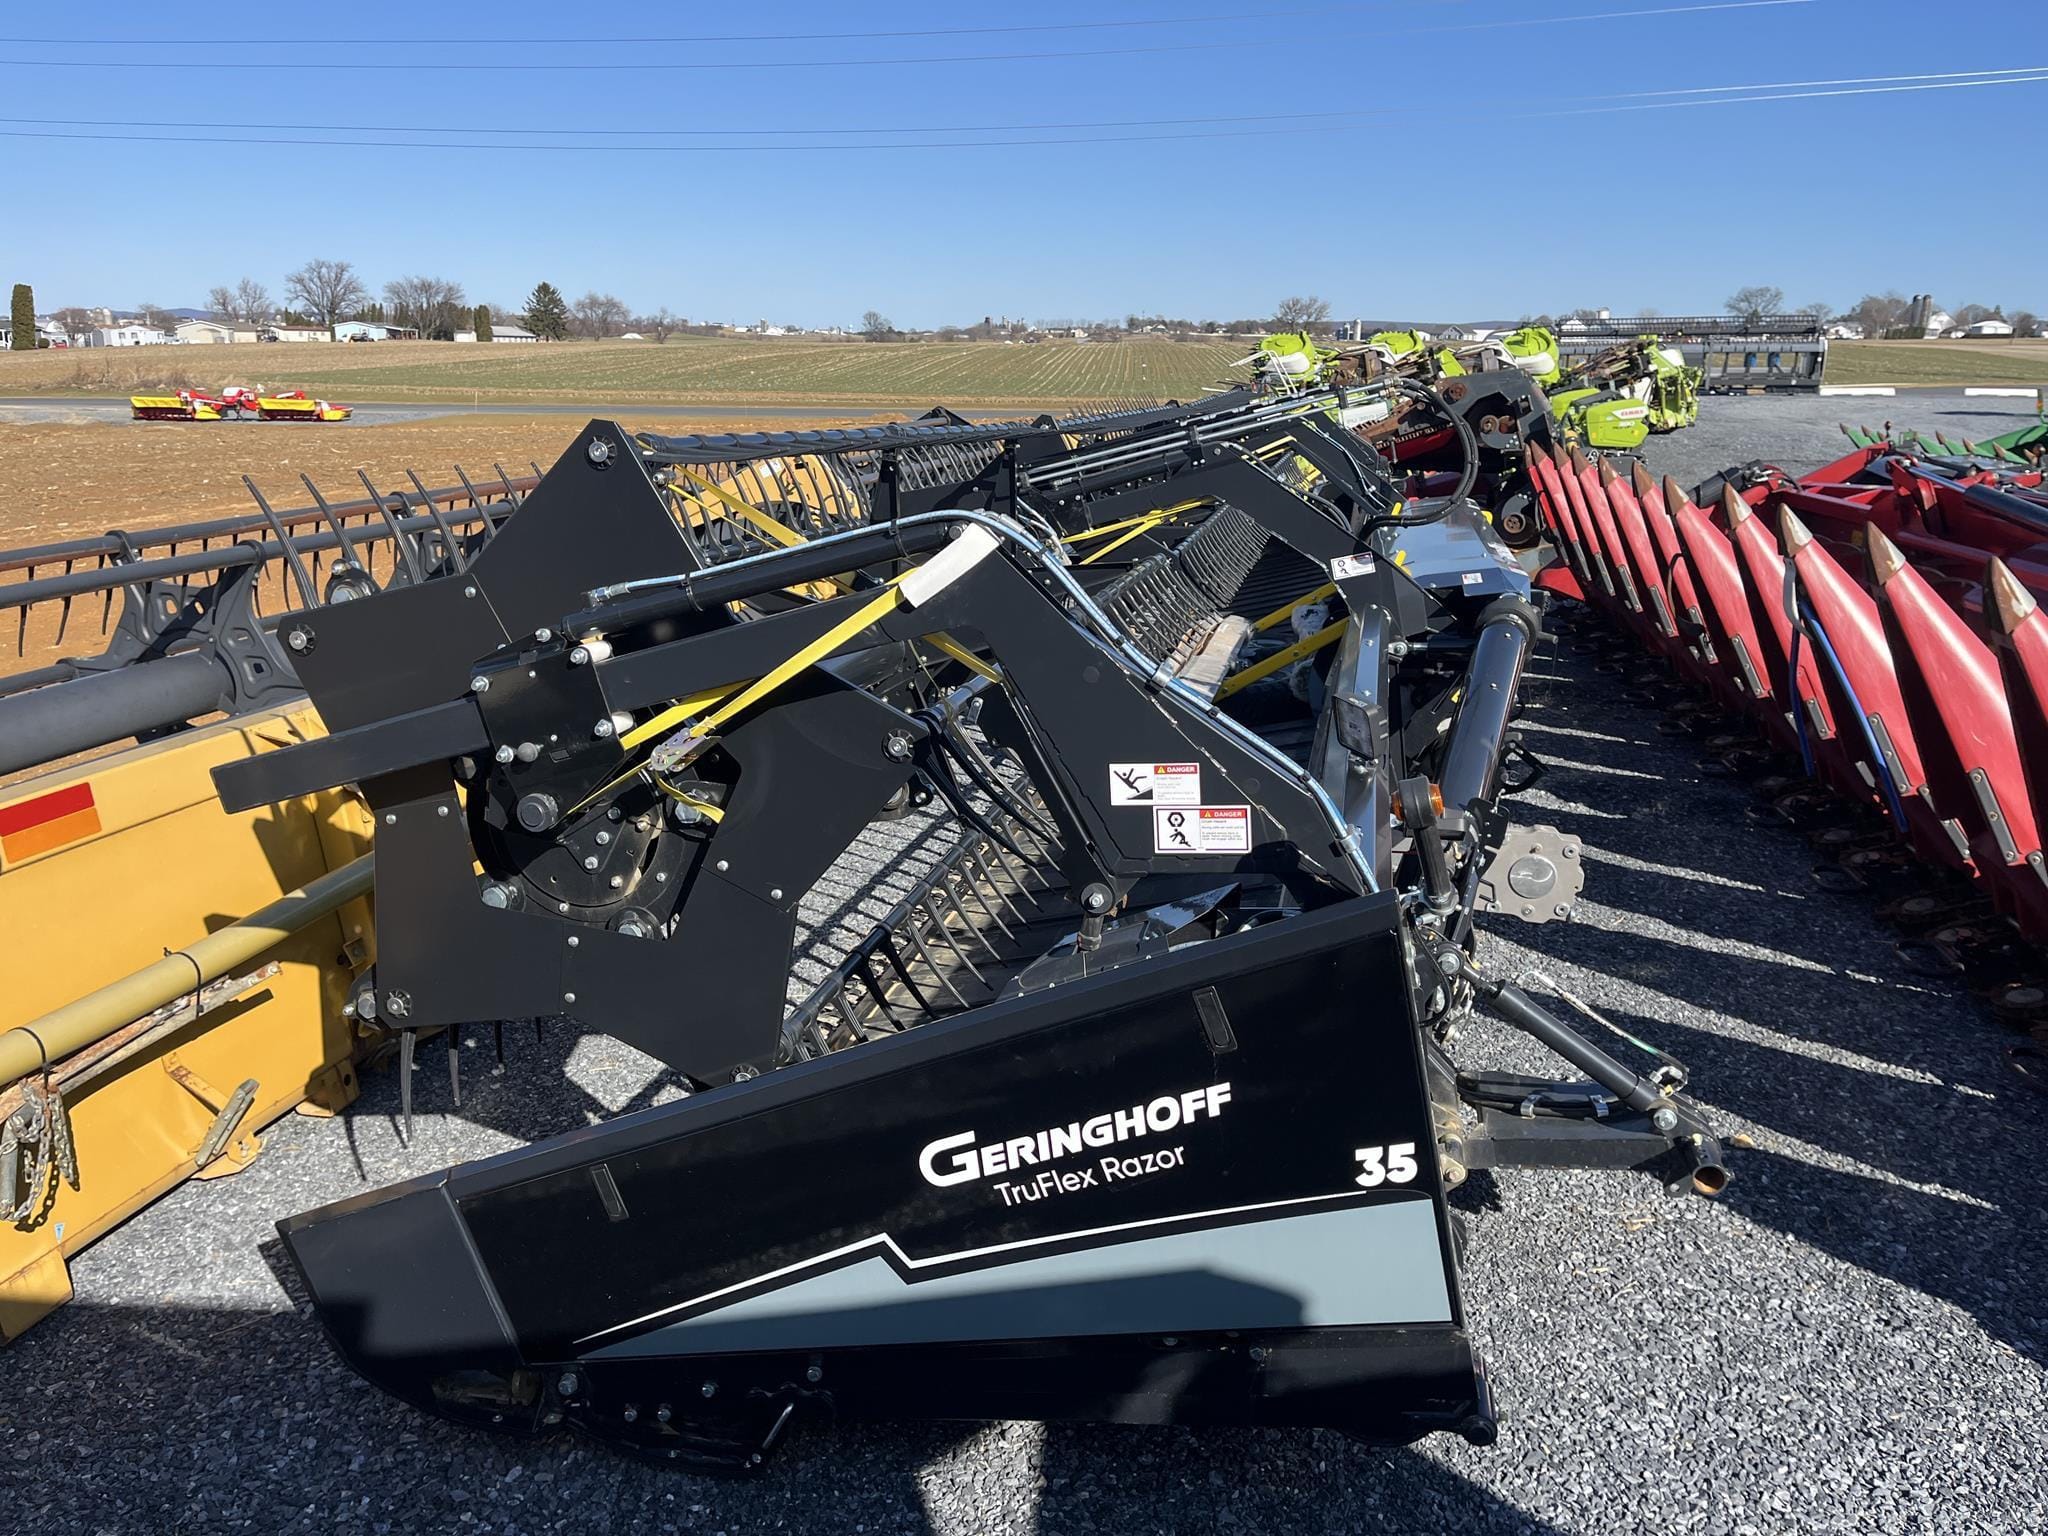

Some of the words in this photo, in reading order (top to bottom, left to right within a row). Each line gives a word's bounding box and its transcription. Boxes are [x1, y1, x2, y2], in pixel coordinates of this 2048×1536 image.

[919, 1082, 1232, 1187] GERINGHOFF
[1354, 1142, 1418, 1187] 35
[993, 1167, 1098, 1207] TruFlex
[1104, 1143, 1186, 1182] Razor
